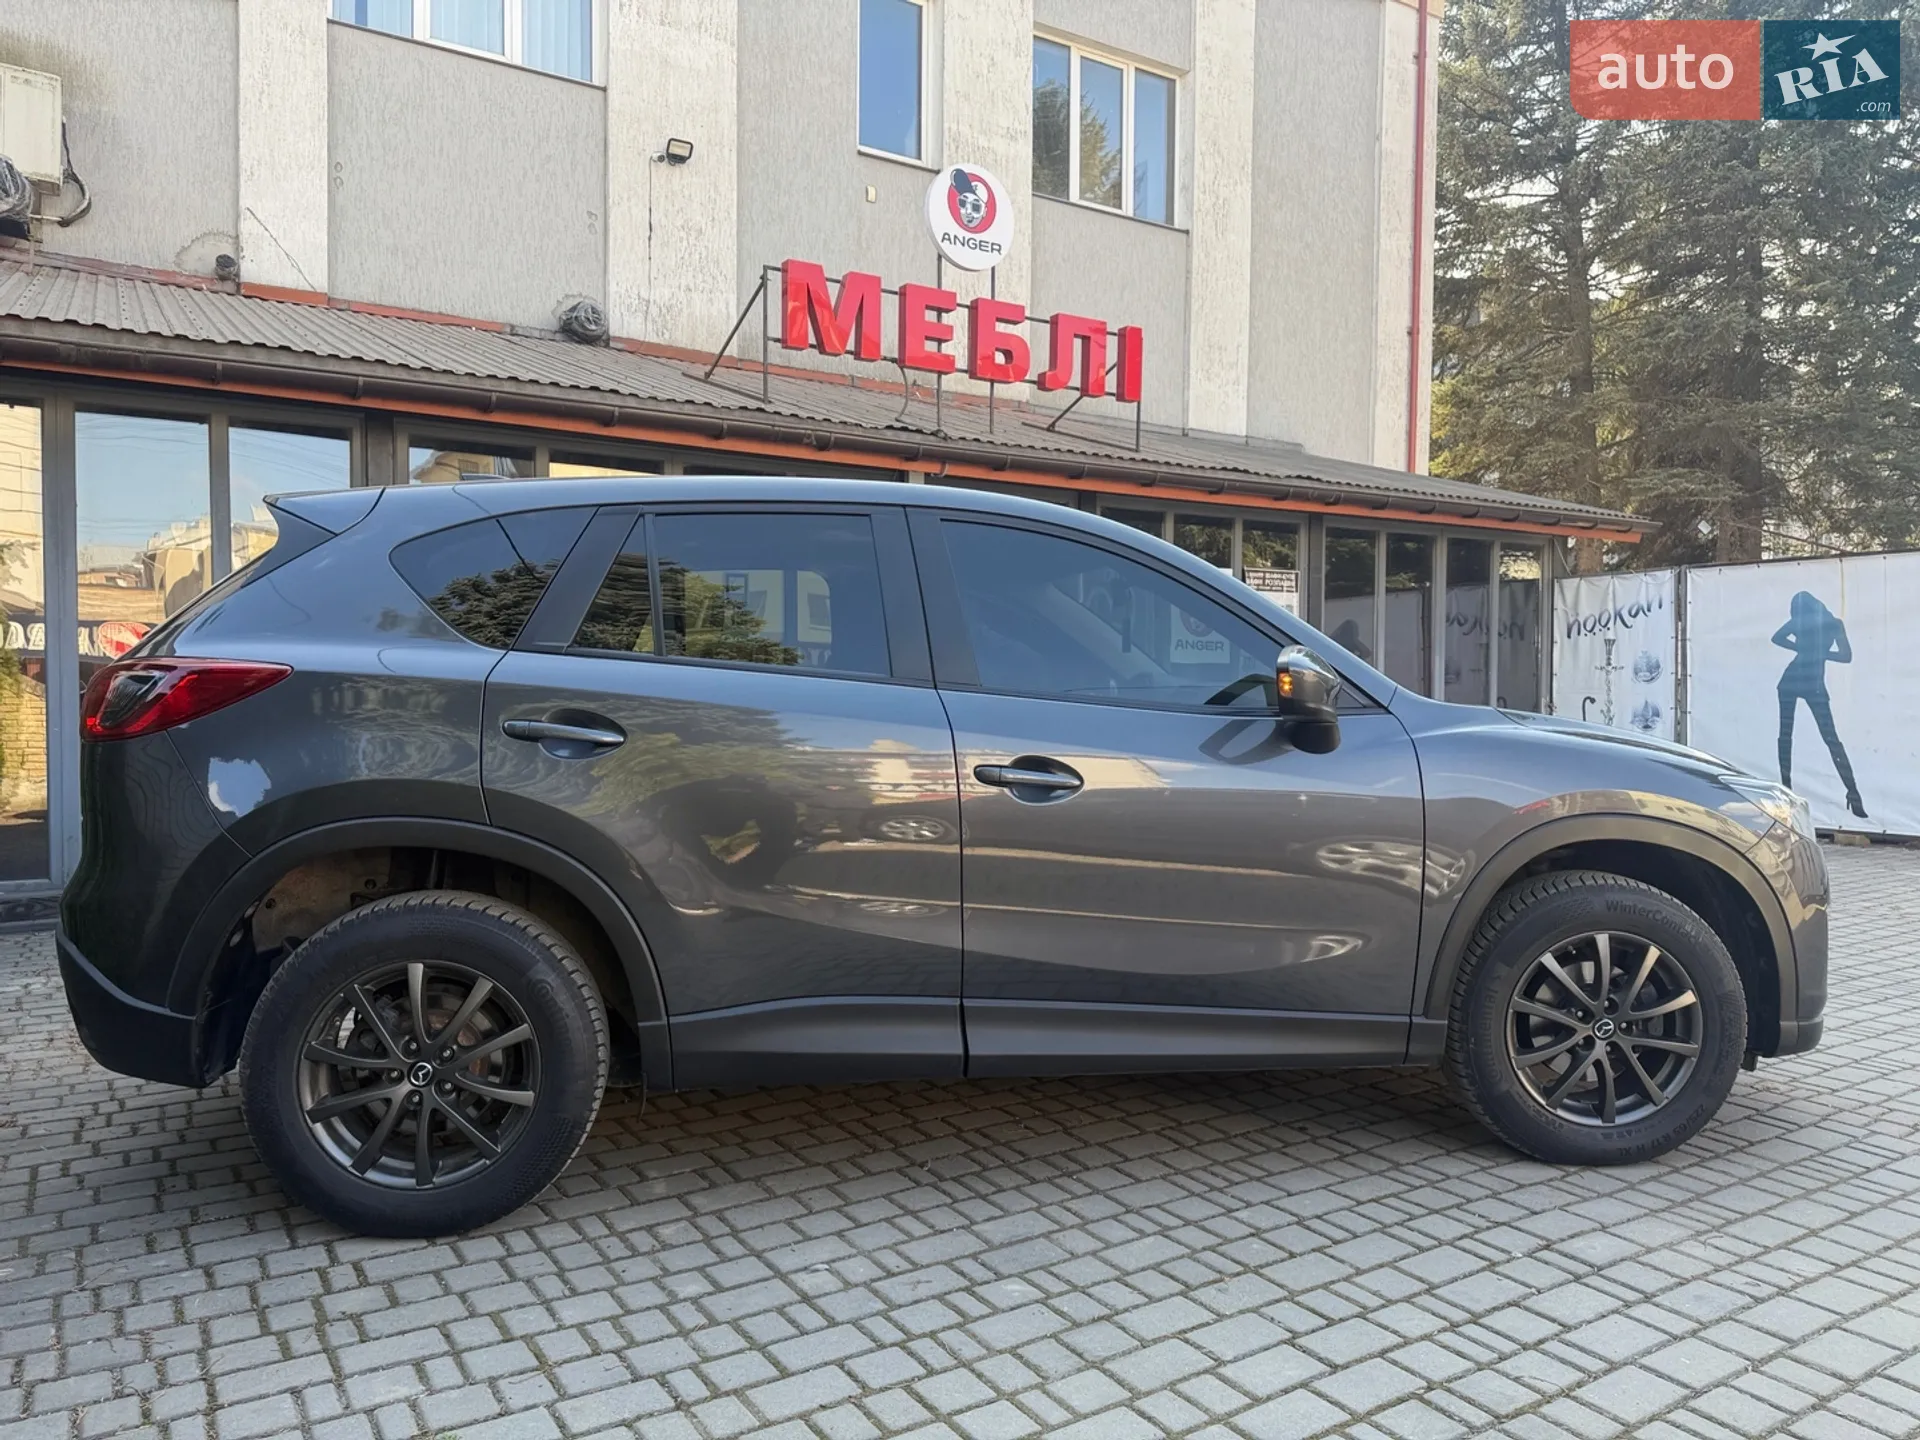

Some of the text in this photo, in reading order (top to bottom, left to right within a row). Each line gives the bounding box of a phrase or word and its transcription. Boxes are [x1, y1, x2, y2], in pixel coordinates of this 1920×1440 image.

[941, 231, 1002, 255] ANGER
[781, 259, 1142, 402] МЕБЛІ
[1174, 639, 1225, 652] ANGER
